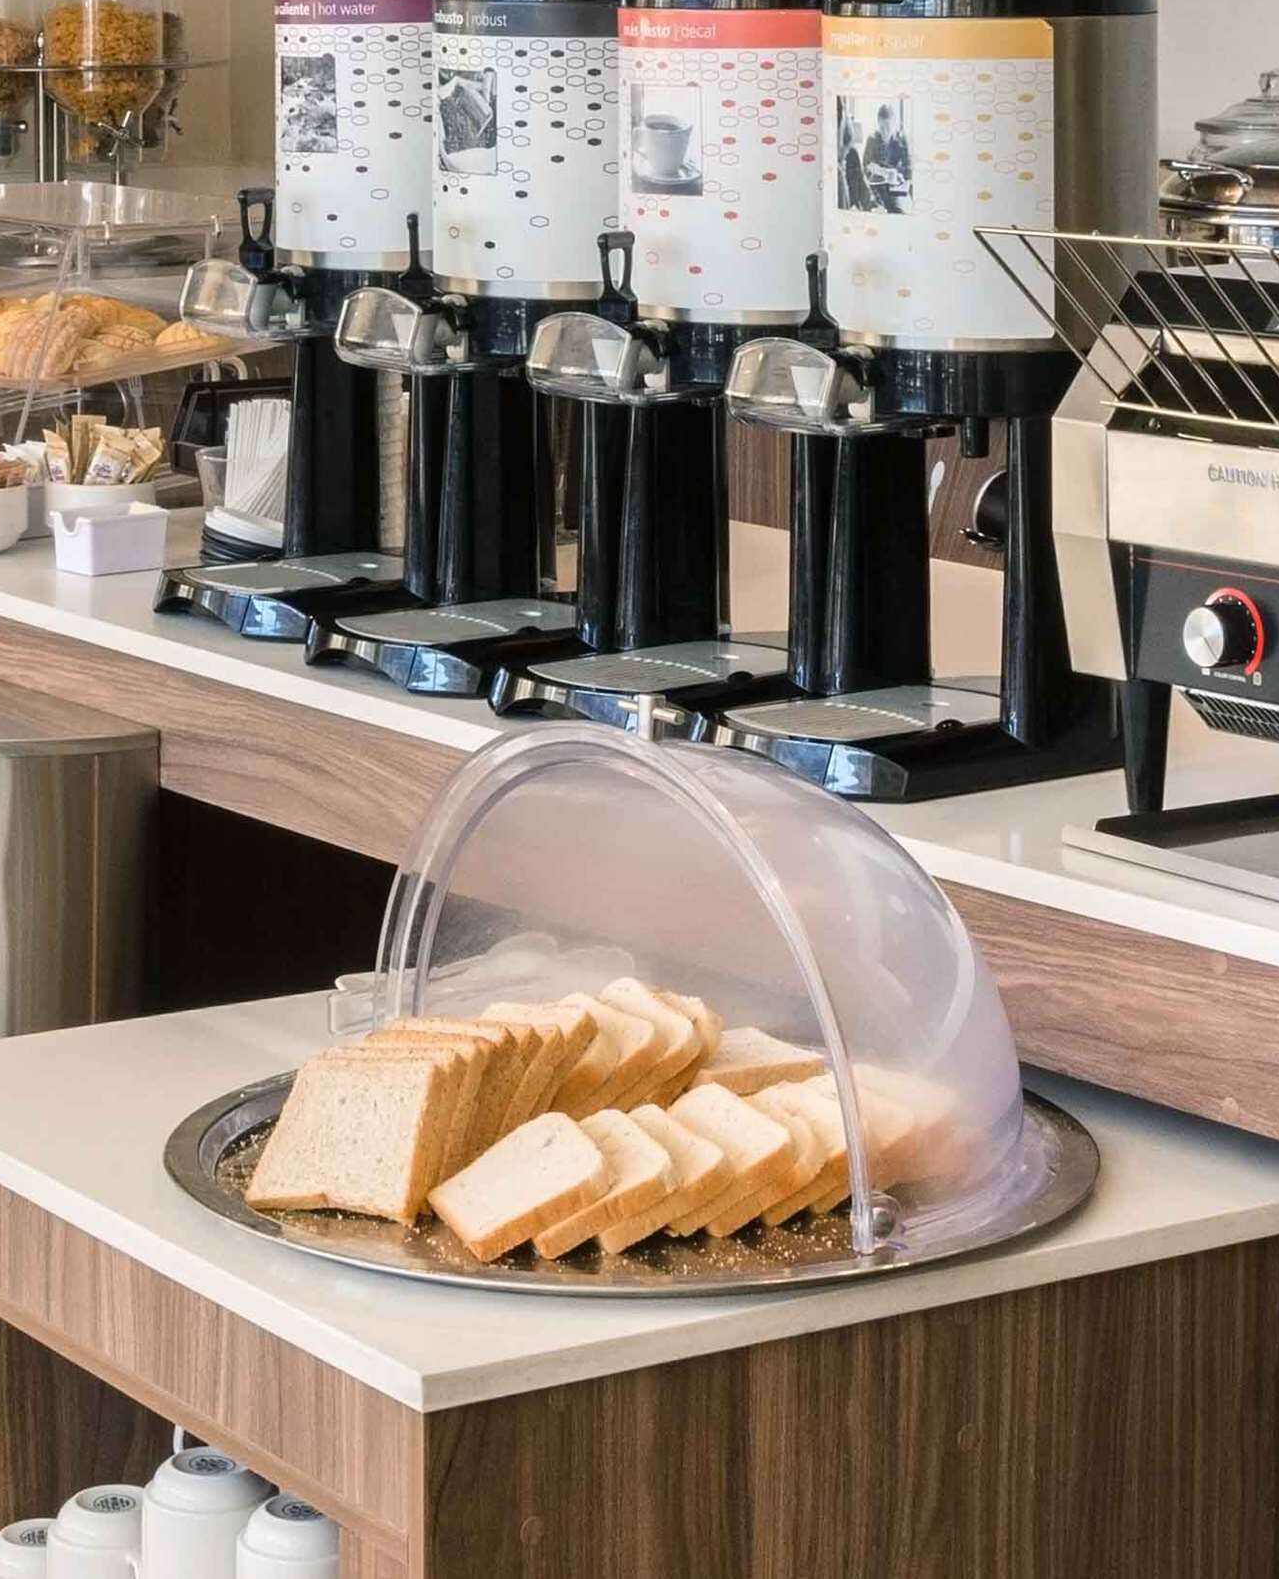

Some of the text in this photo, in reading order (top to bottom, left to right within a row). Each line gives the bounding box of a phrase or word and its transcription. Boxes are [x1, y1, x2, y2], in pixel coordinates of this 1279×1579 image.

[318, 2, 337, 16] hot
[339, 2, 377, 16] water
[471, 11, 508, 27] robust
[1207, 463, 1268, 488] CAUTION
